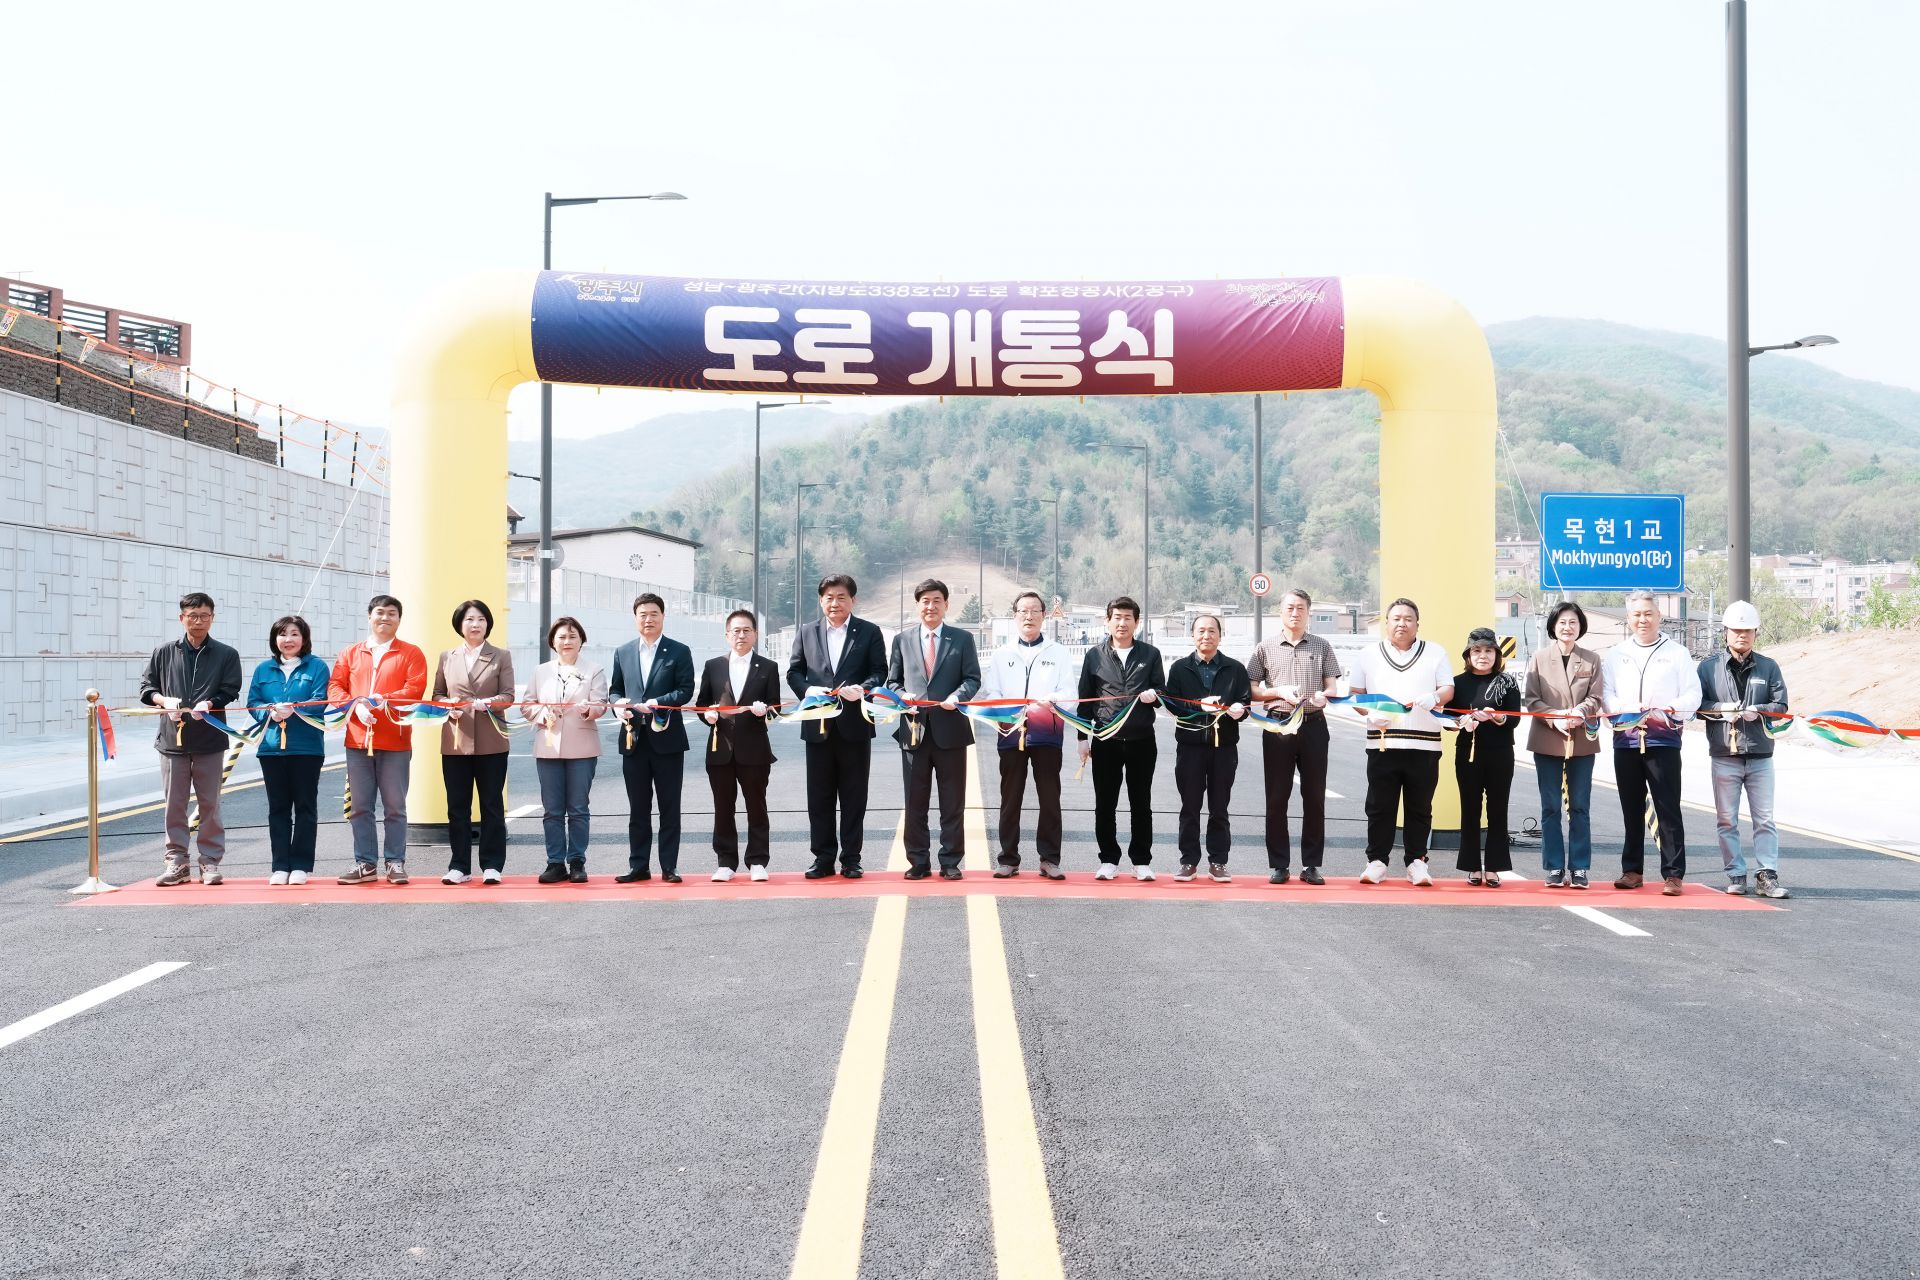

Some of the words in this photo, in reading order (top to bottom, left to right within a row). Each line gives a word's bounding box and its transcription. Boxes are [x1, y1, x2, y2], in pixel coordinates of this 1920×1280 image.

[577, 279, 643, 297] 광주시
[967, 285, 1008, 298] 도로
[1018, 284, 1194, 298] 확포장공사(2공구)
[702, 305, 879, 385] 도로
[907, 308, 1174, 388] 개통식
[1551, 549, 1672, 569] Mokhyungyo1(Br)
[1254, 580, 1266, 590] 50
